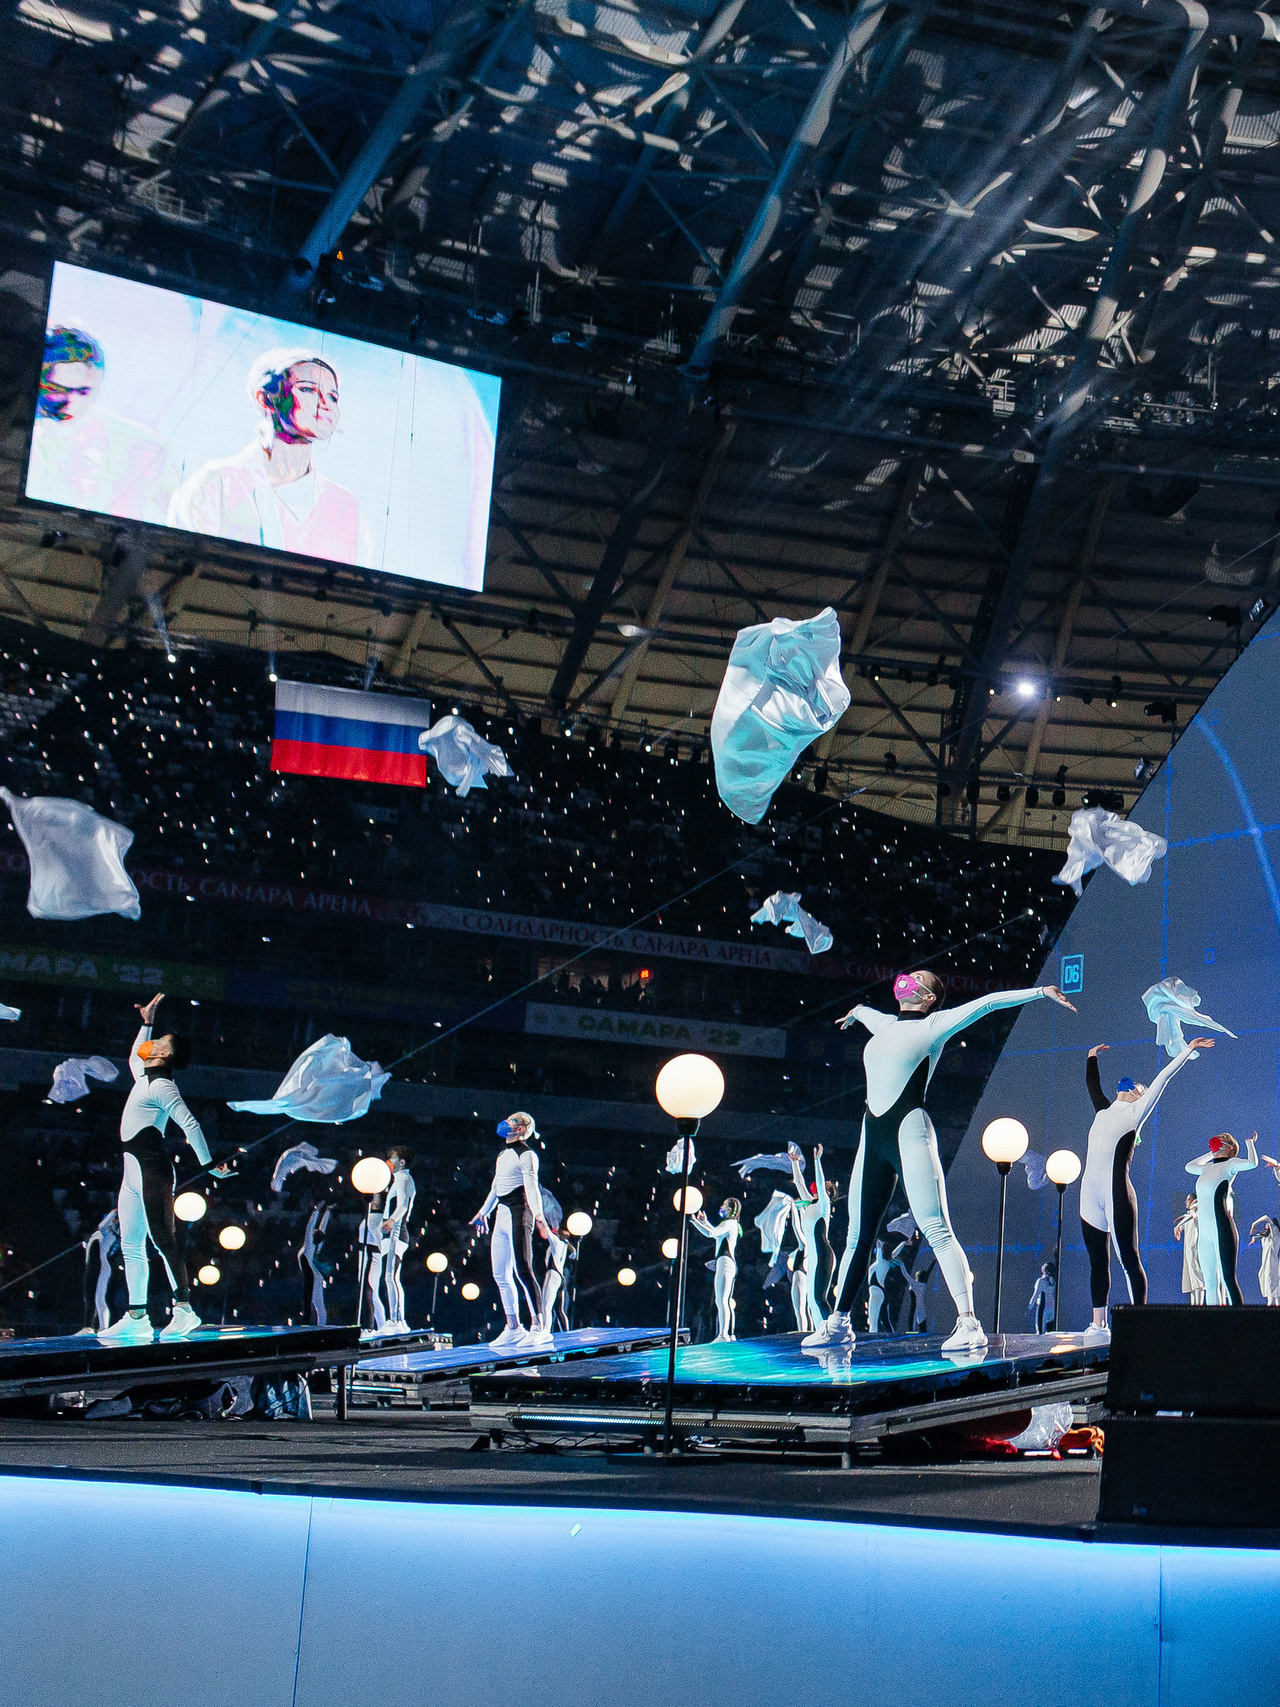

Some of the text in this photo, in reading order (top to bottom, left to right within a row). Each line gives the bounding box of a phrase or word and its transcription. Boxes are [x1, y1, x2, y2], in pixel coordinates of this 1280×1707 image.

[632, 929, 709, 958] САМАРА
[717, 945, 772, 965] АРЕНА
[1065, 964, 1079, 984] 06
[578, 1014, 692, 1042] САМАРА
